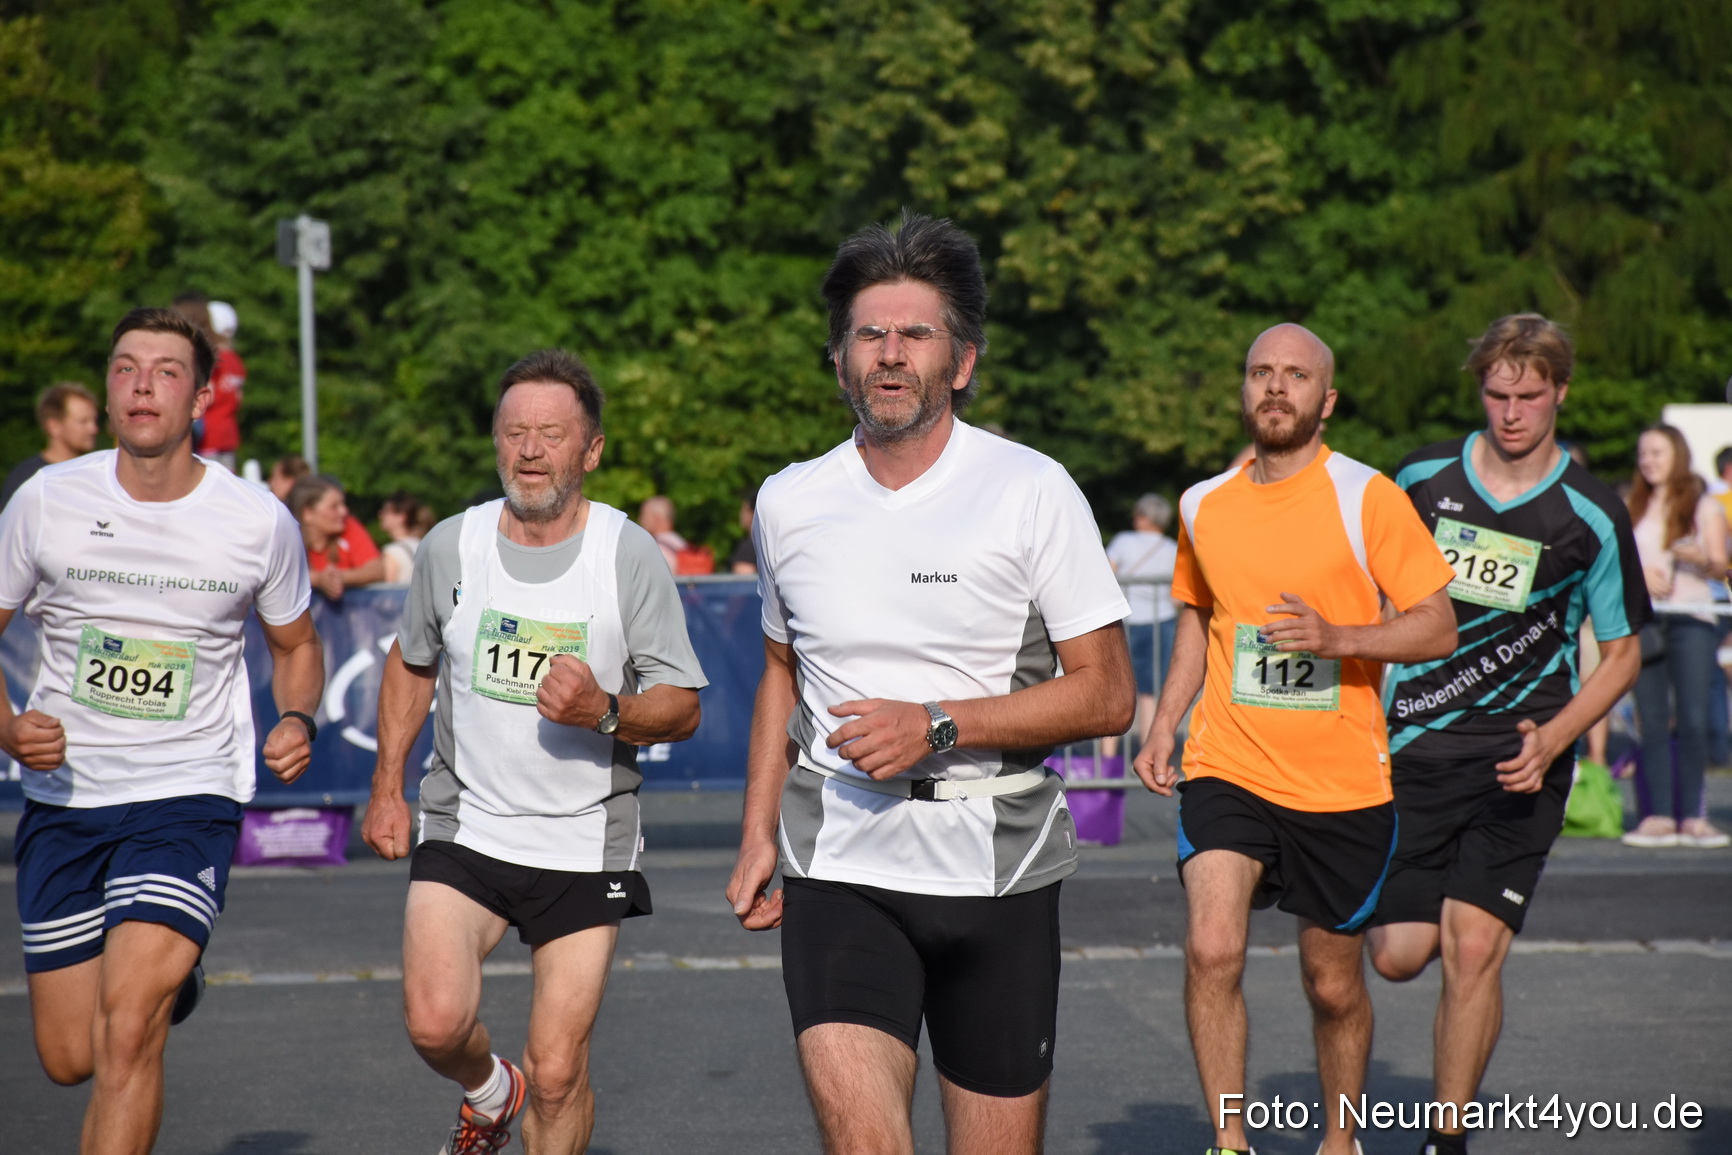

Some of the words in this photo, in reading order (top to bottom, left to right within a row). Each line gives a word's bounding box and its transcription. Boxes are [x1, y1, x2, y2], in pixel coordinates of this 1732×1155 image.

[90, 530, 114, 538] erima
[1443, 548, 1519, 590] 2182
[66, 567, 157, 587] RUPPRECHT
[166, 577, 239, 594] HOLZBAU
[911, 571, 958, 584] Markus
[558, 645, 580, 653] 2019
[164, 662, 186, 670] 2019
[487, 643, 564, 681] 117
[1479, 656, 1498, 674] &
[86, 658, 174, 698] 2094
[1255, 656, 1315, 688] 112
[486, 673, 535, 690] Puschmann
[89, 686, 135, 704] Rupprecht
[138, 697, 167, 708] Tobias
[522, 689, 537, 697] Gmb
[1260, 686, 1289, 696] Spotka
[1291, 689, 1307, 697] Jan
[89, 695, 119, 707] Rupprecht
[606, 891, 627, 899] erima
